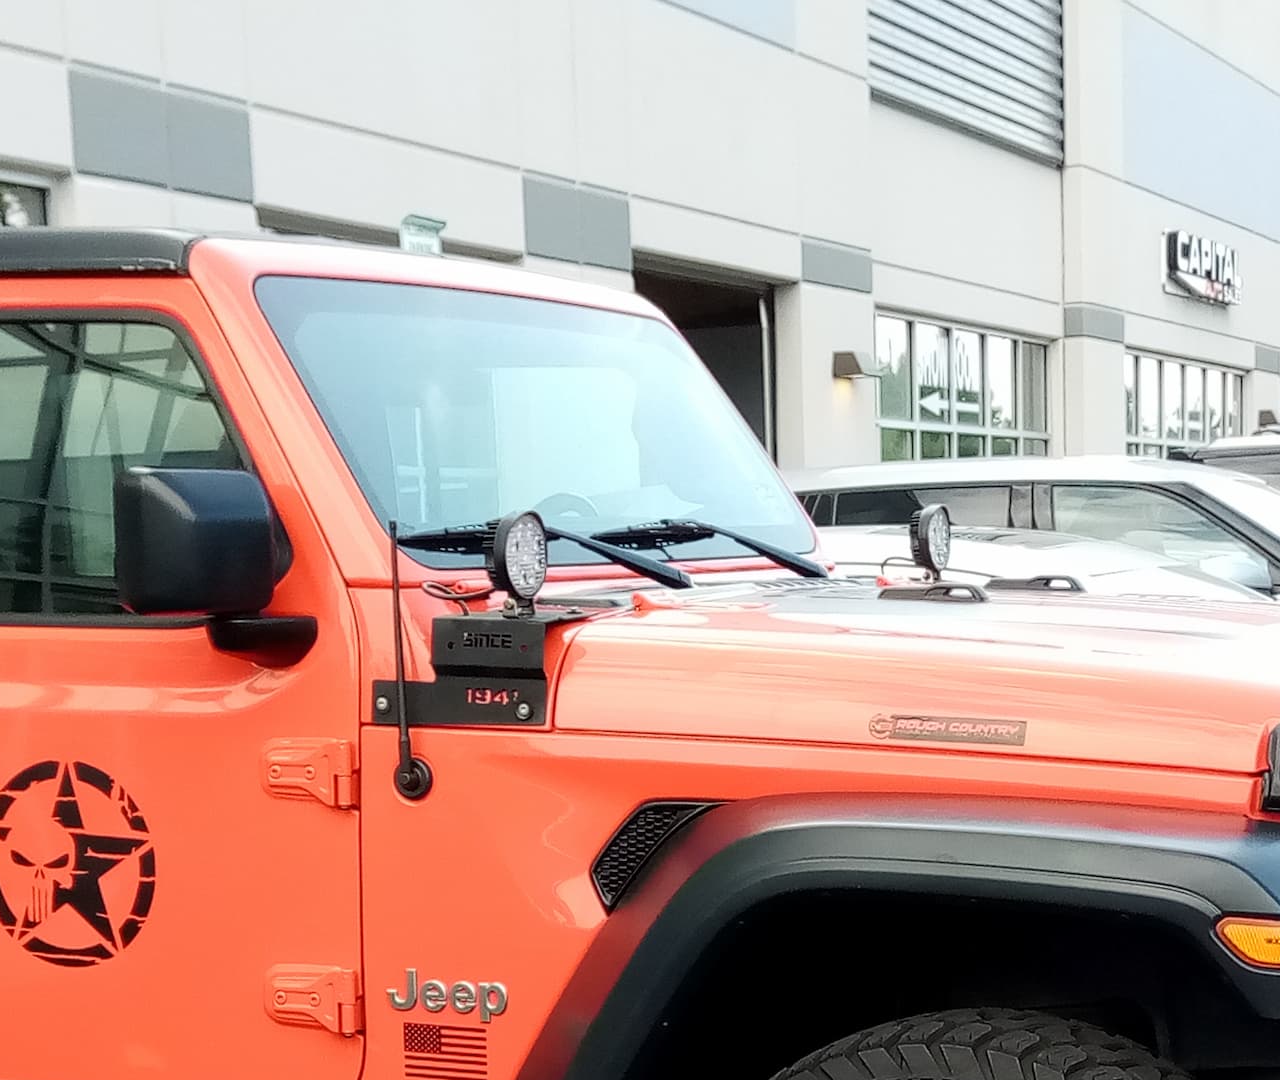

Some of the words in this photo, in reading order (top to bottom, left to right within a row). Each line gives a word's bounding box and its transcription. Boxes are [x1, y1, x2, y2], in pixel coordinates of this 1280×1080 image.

[1176, 230, 1242, 290] CAPITAL
[895, 718, 946, 732] ROUGH
[948, 722, 1020, 735] COUNTRY
[385, 967, 508, 1023] Jeep
